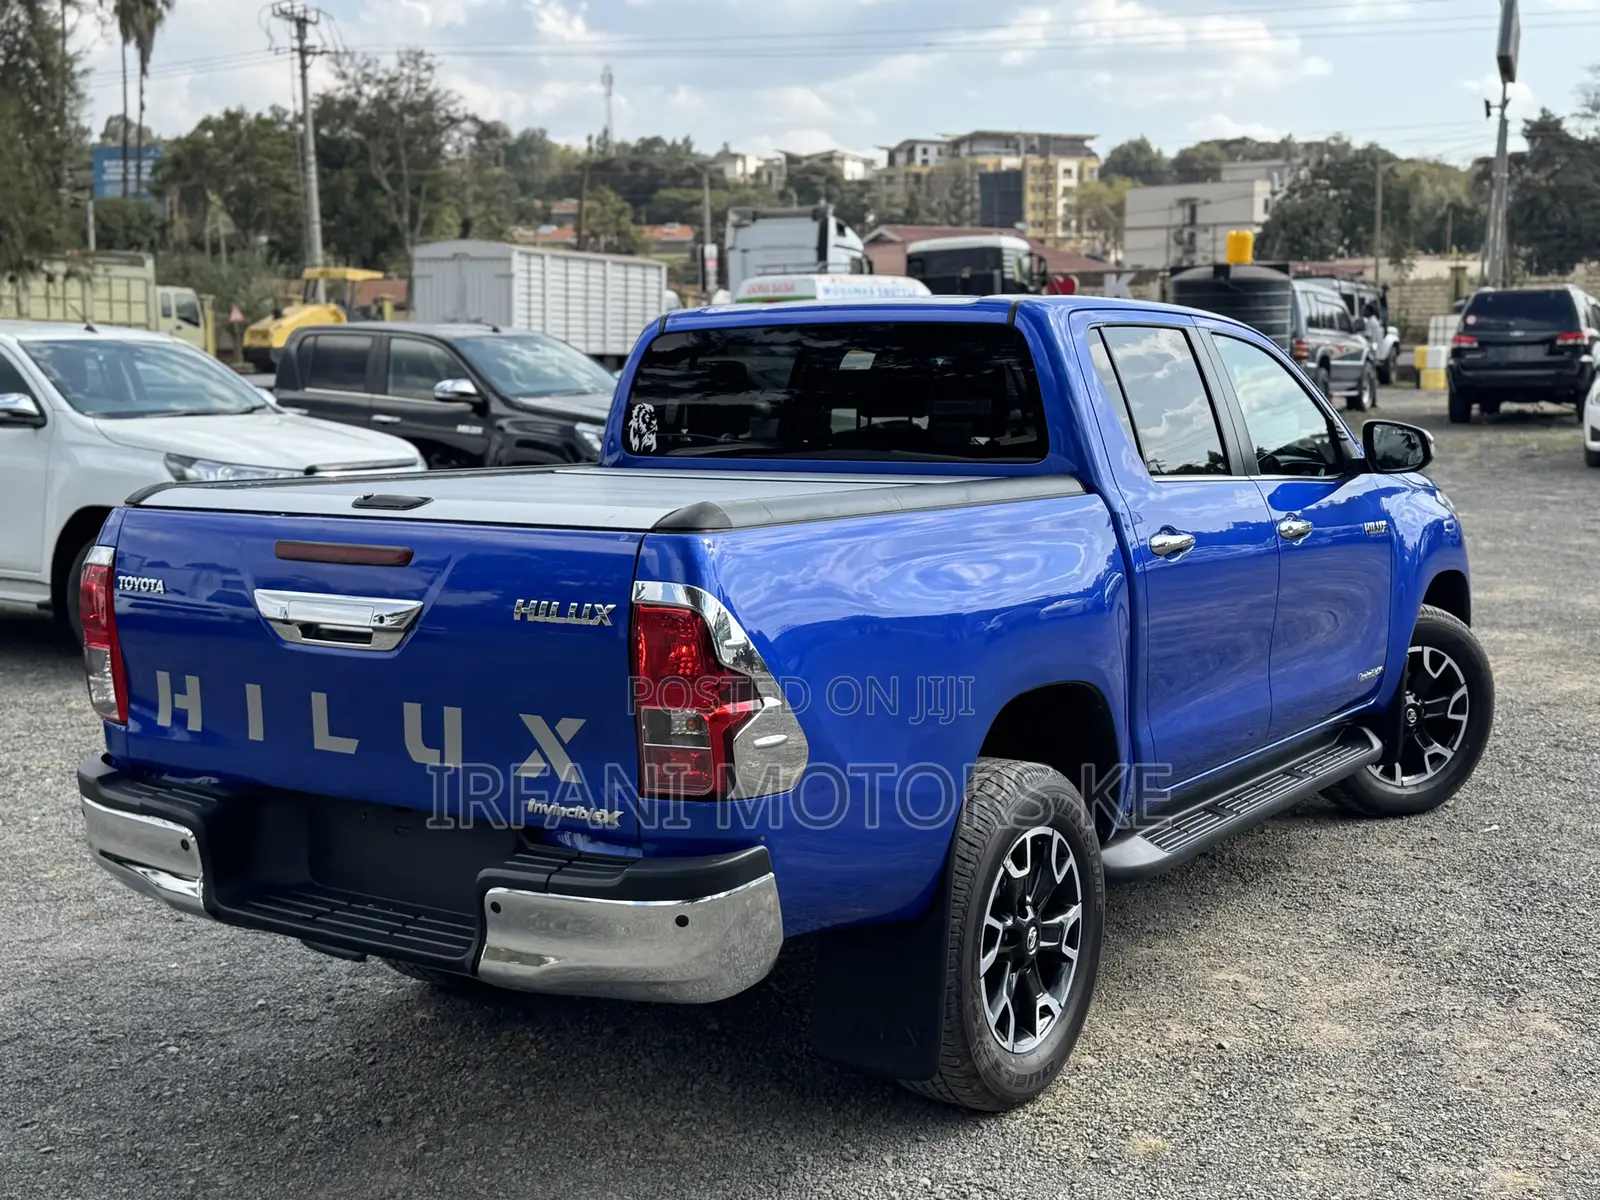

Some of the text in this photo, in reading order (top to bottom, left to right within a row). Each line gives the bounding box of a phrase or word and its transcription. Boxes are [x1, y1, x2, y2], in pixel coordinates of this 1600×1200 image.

[118, 575, 164, 594] TOYOTA
[513, 599, 617, 626] HILUX
[156, 670, 587, 784] HILUX
